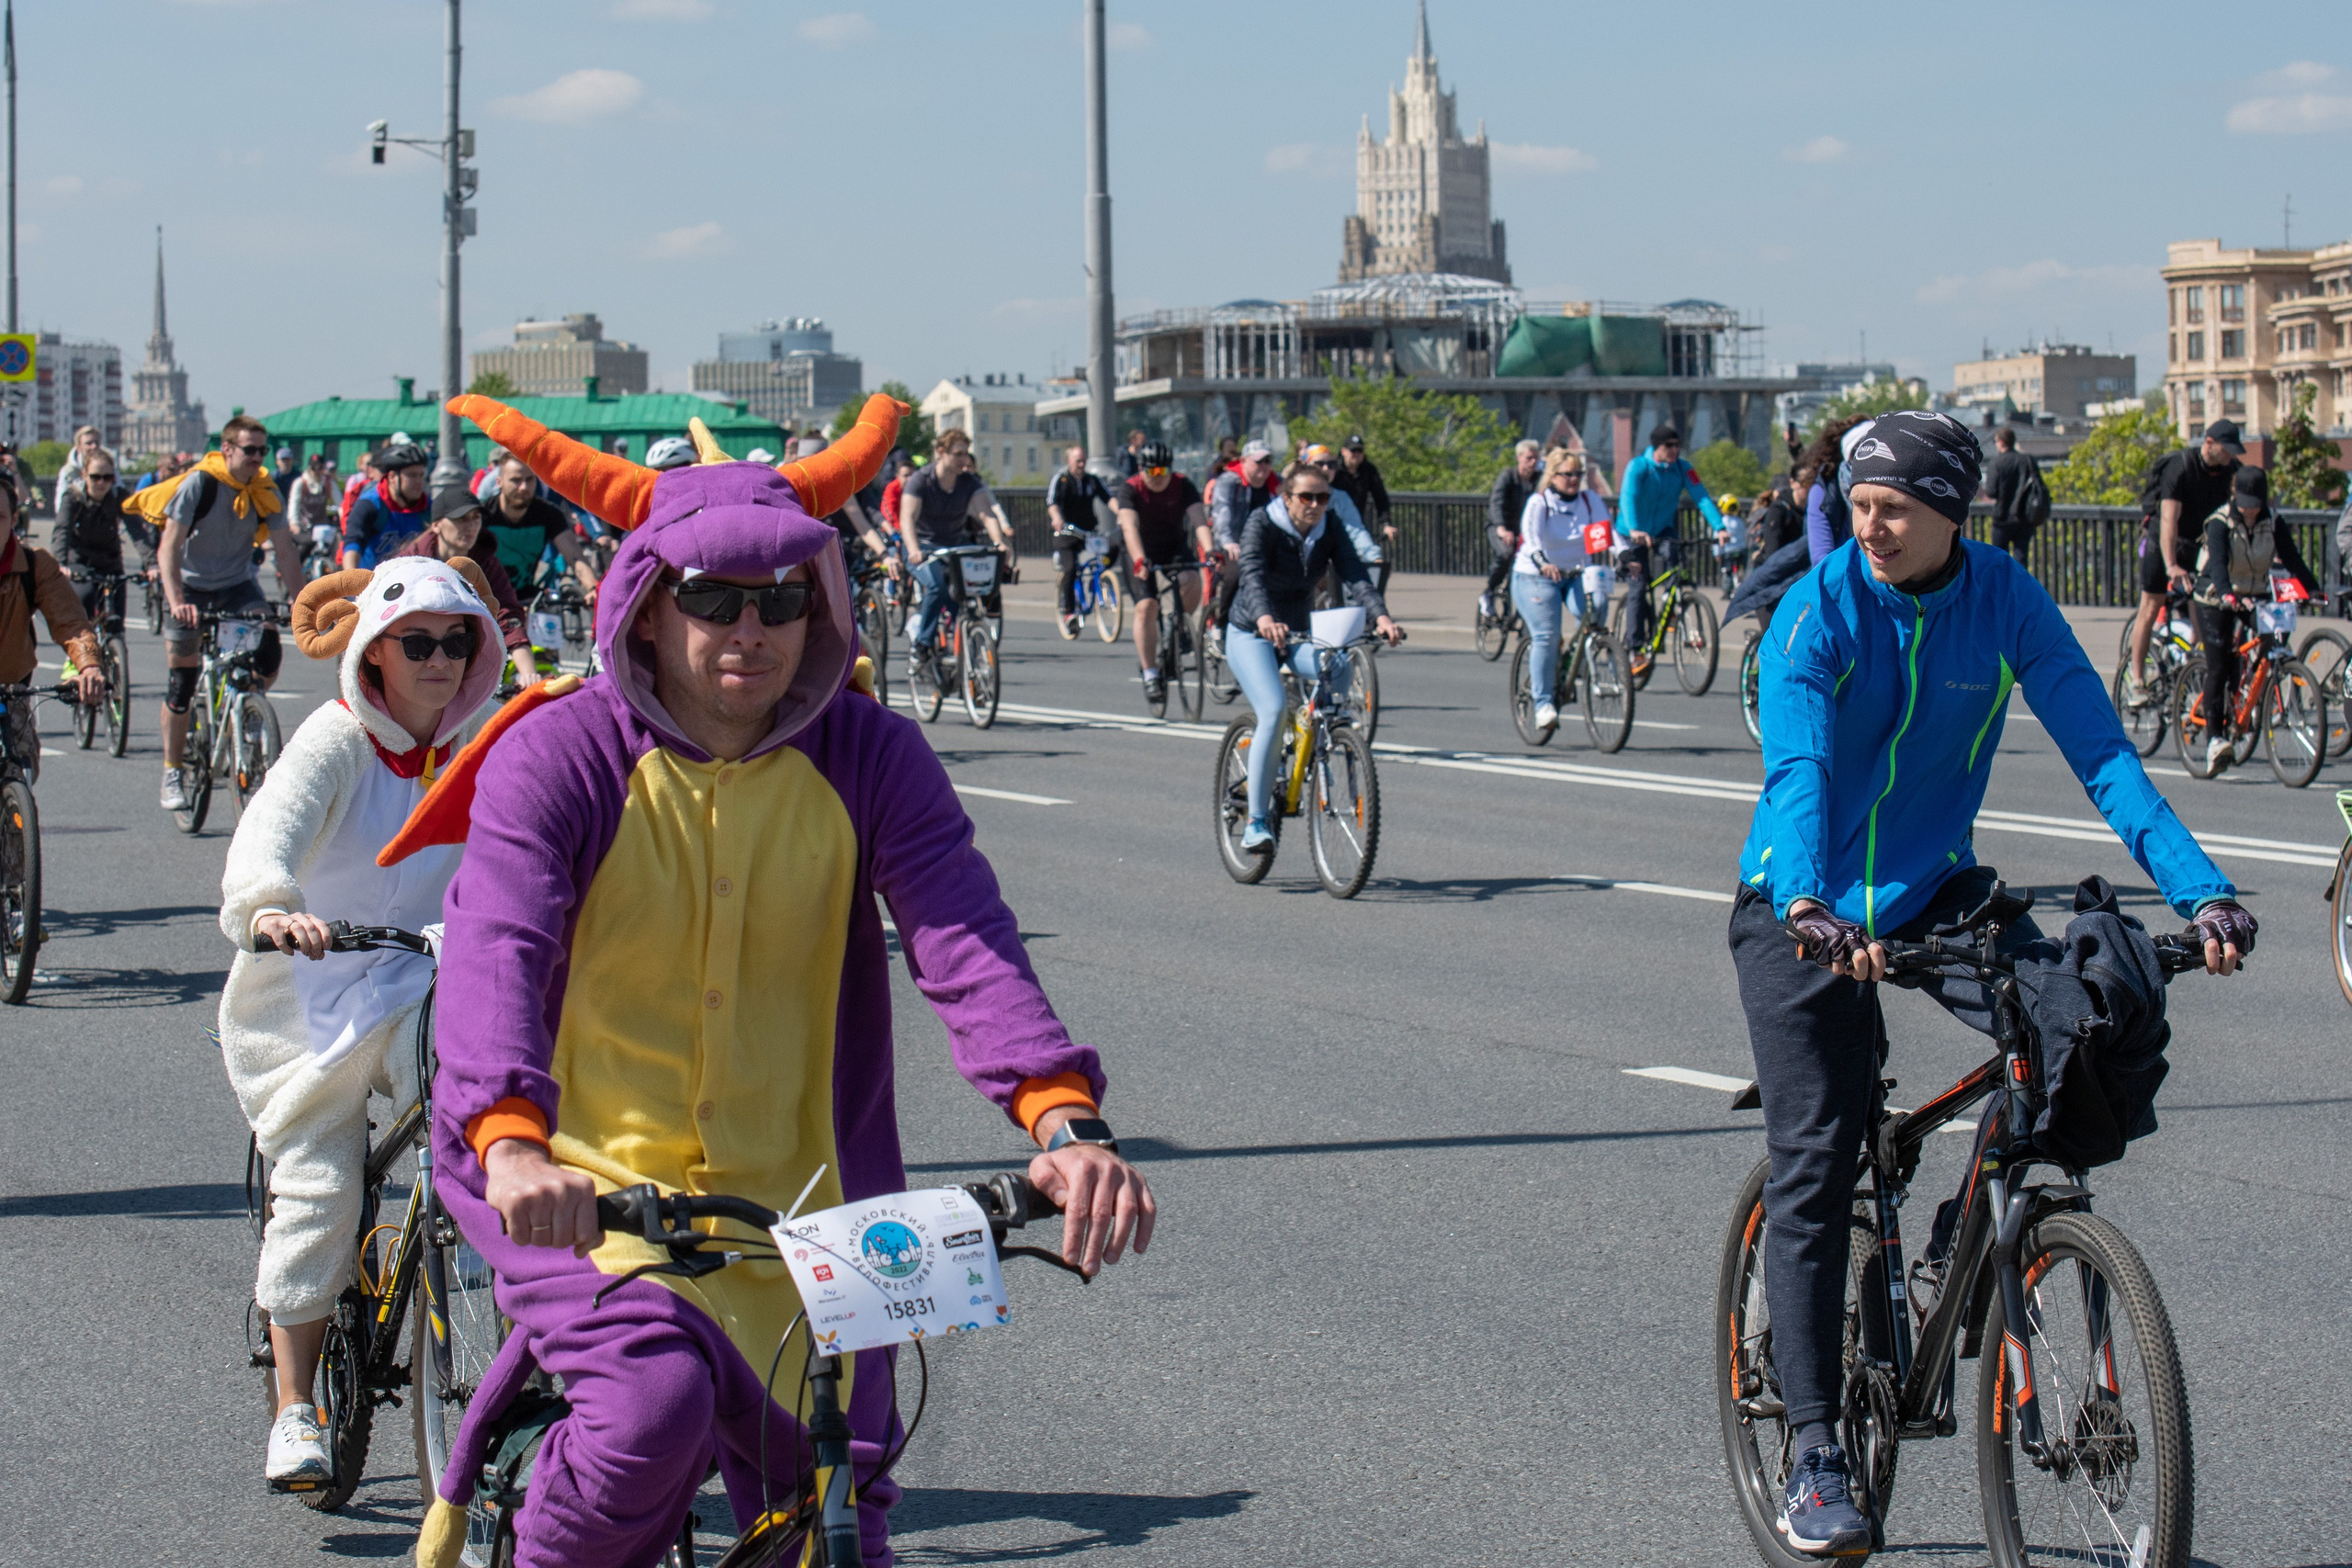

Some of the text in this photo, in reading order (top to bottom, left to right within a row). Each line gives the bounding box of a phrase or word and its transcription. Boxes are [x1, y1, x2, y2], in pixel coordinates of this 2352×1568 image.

[1931, 482, 1946, 491] MINI
[849, 1209, 926, 1247] МОСКОВСКИЙ
[852, 1242, 935, 1292] ВЕЛОФЕСТИВАЛЬ
[890, 1266, 908, 1274] 2022
[1895, 1287, 1903, 1296] L
[884, 1296, 935, 1320] 15831
